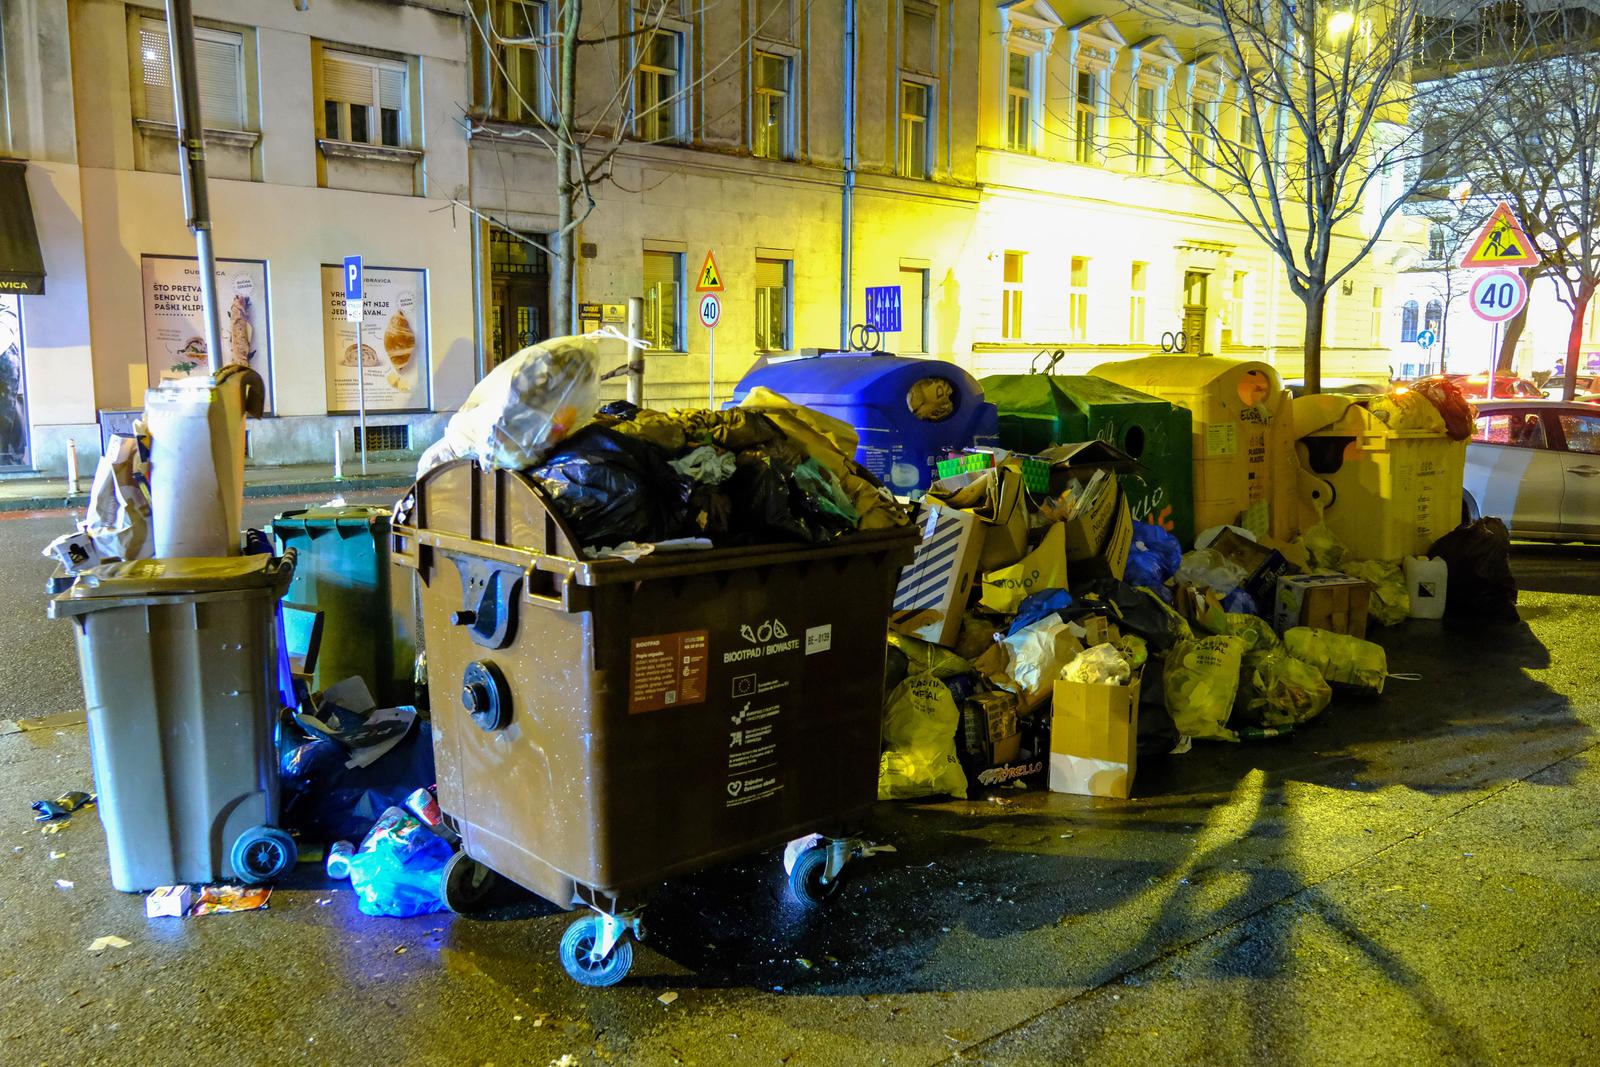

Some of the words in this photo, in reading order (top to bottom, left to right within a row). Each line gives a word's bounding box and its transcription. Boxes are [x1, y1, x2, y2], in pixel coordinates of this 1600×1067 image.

[153, 282, 168, 291] ŠTO
[348, 264, 358, 292] P
[153, 293, 191, 301] SENDVIČ
[1480, 283, 1514, 309] 40
[154, 302, 180, 311] PAŠKI
[703, 302, 716, 319] 40
[723, 647, 762, 664] BIOOTPAD
[766, 639, 800, 656] BIOWASTE
